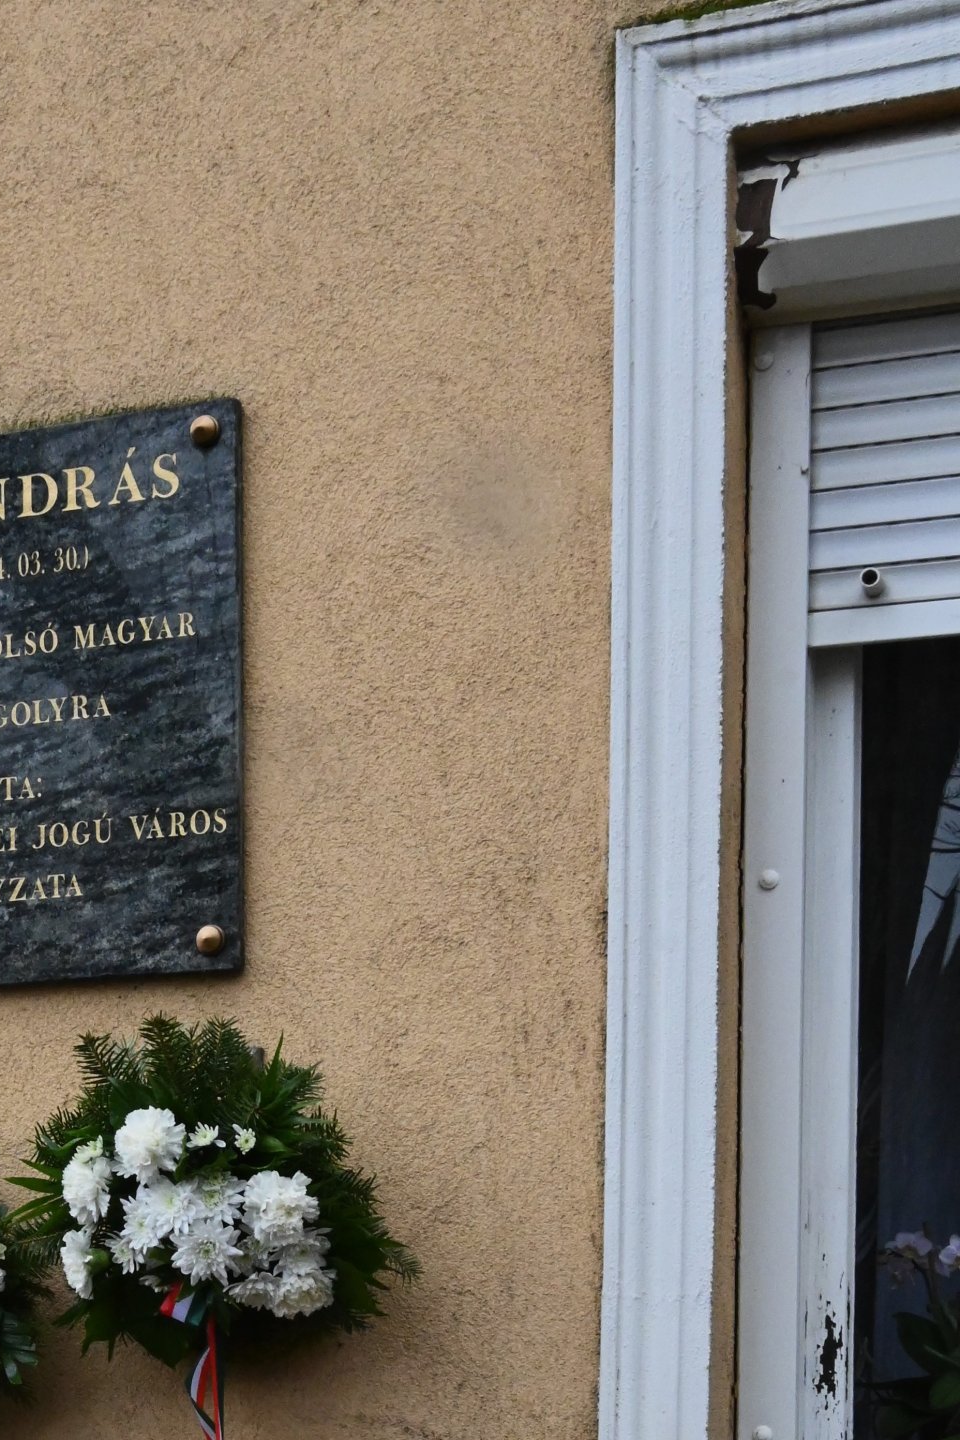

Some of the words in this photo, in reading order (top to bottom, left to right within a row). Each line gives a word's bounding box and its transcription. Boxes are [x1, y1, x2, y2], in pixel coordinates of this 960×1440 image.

[17, 551, 46, 577] 03.
[54, 547, 88, 572] 30.)
[74, 613, 195, 649] MAGYAR
[33, 812, 110, 849] JOGÚ
[130, 808, 226, 839] VÁROS
